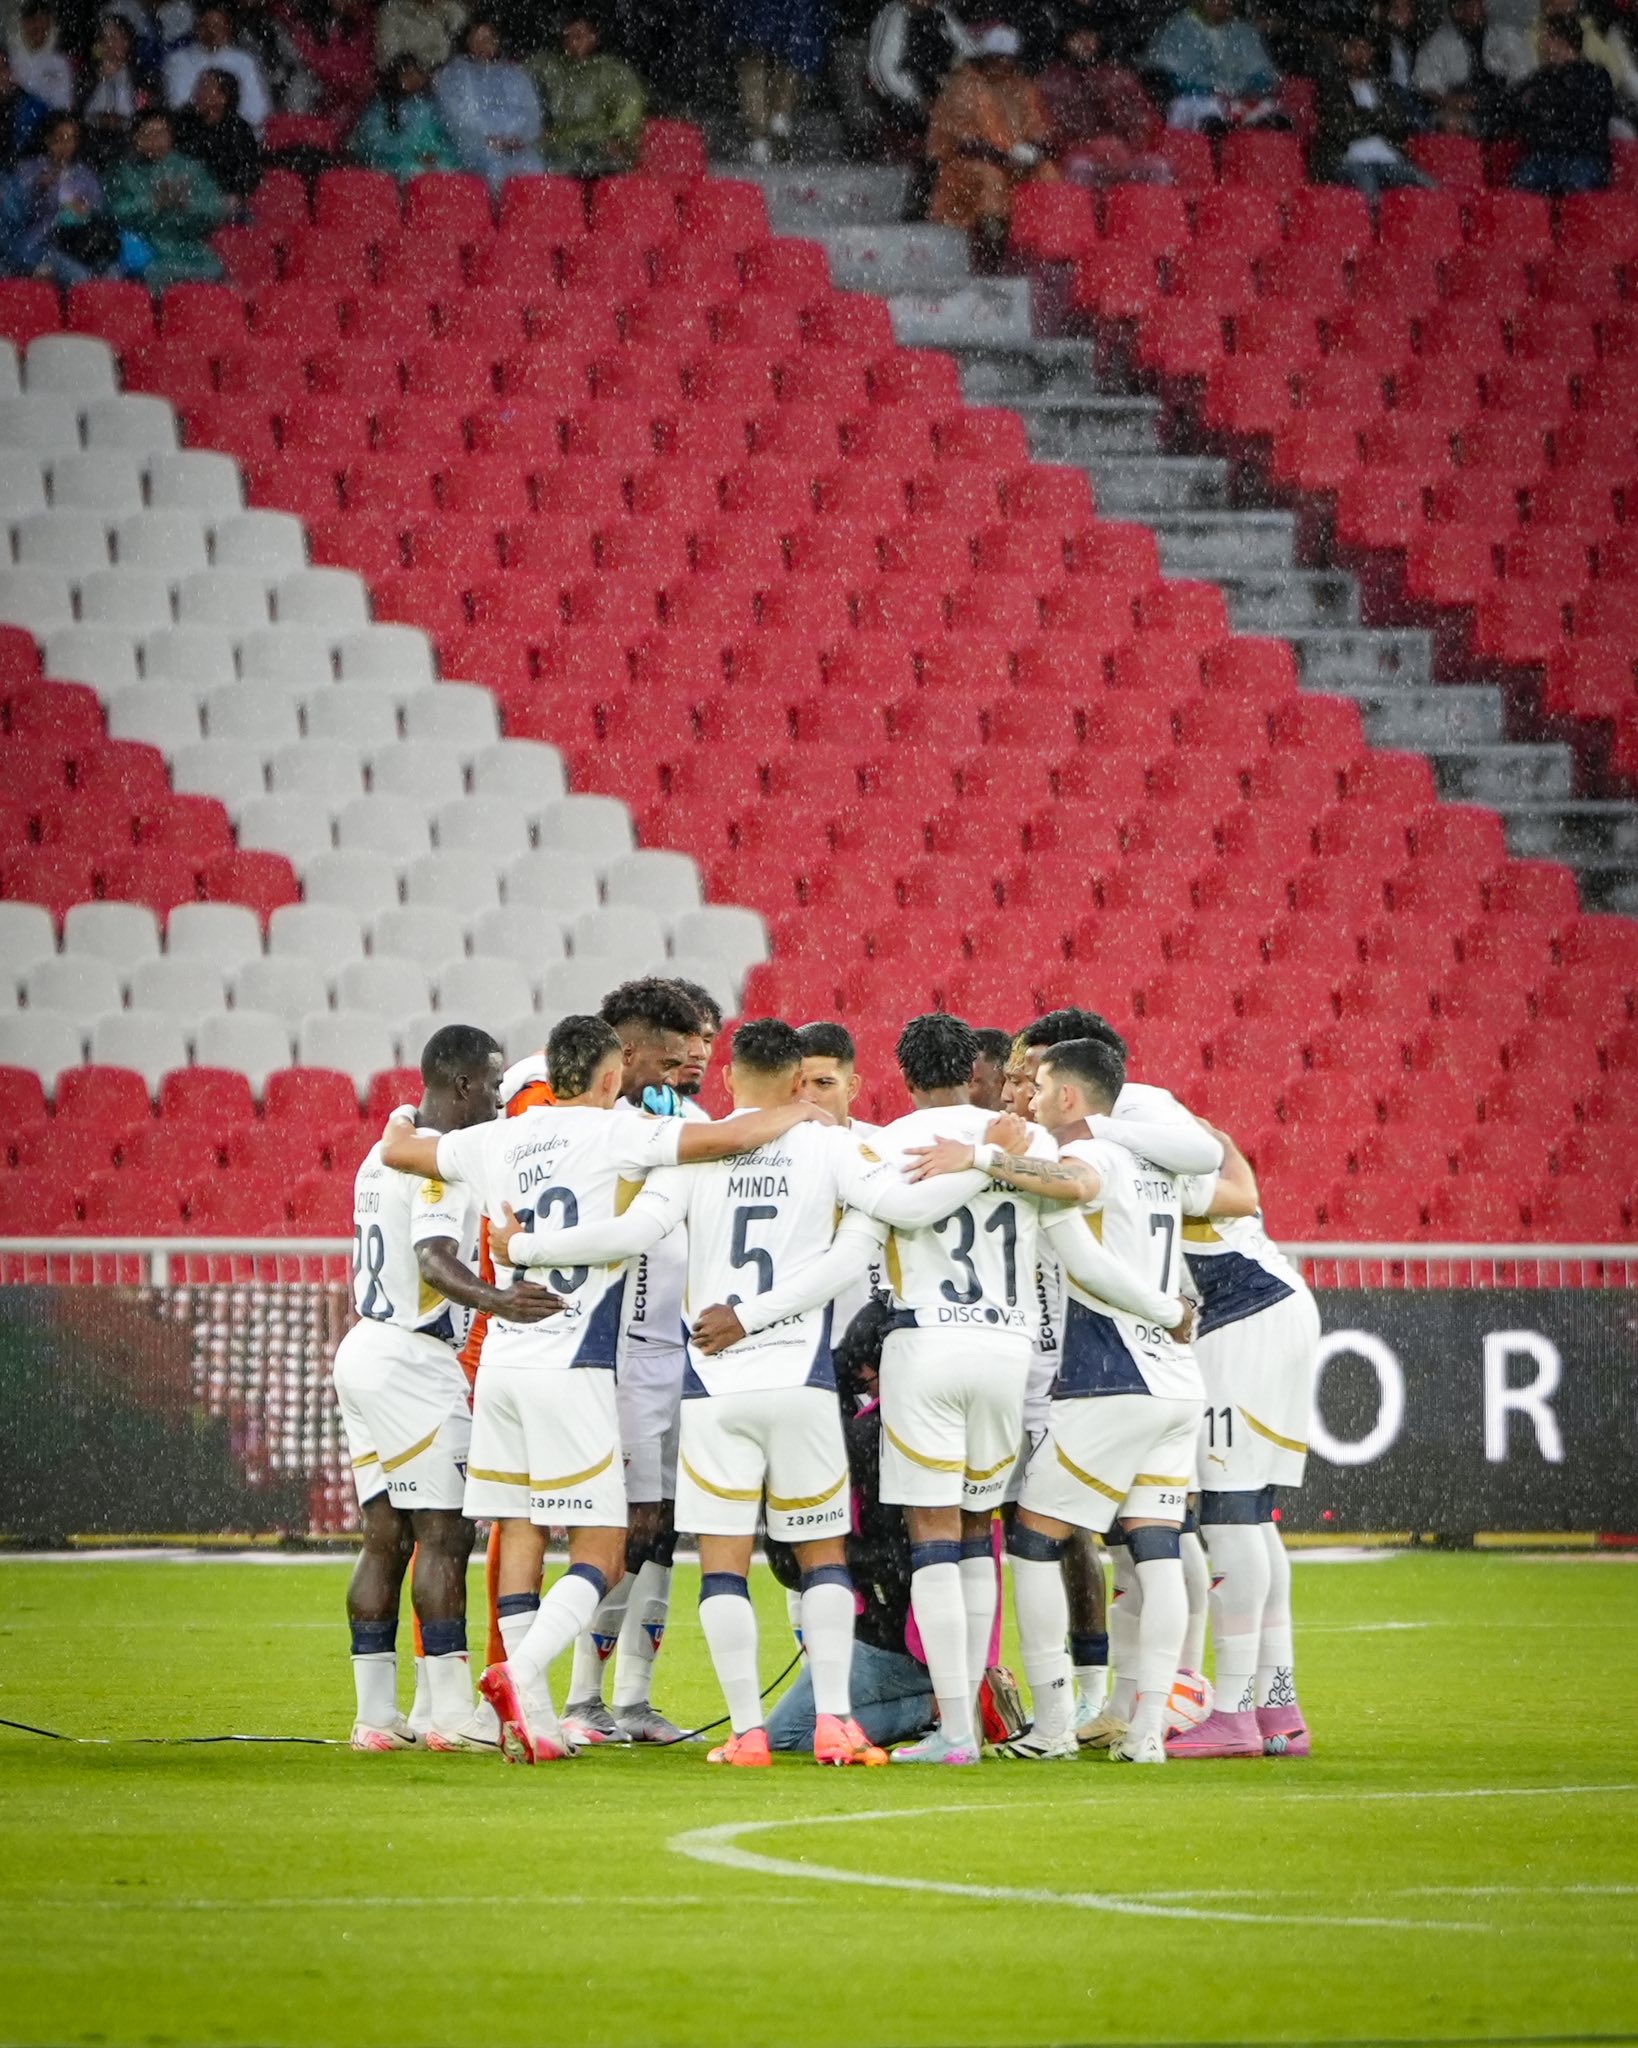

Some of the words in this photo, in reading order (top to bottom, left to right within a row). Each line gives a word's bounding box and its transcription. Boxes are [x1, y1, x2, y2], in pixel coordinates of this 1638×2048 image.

[722, 1146, 793, 1172] Splendor
[518, 1160, 554, 1194] DIAZ
[727, 1176, 789, 1198] MINDA
[730, 1205, 778, 1307] 5
[932, 1201, 1017, 1308] 31
[1150, 1213, 1175, 1293] 7
[938, 1306, 1026, 1327] DISCOVER
[1135, 1324, 1172, 1345] DISC
[1204, 1406, 1232, 1448] 11
